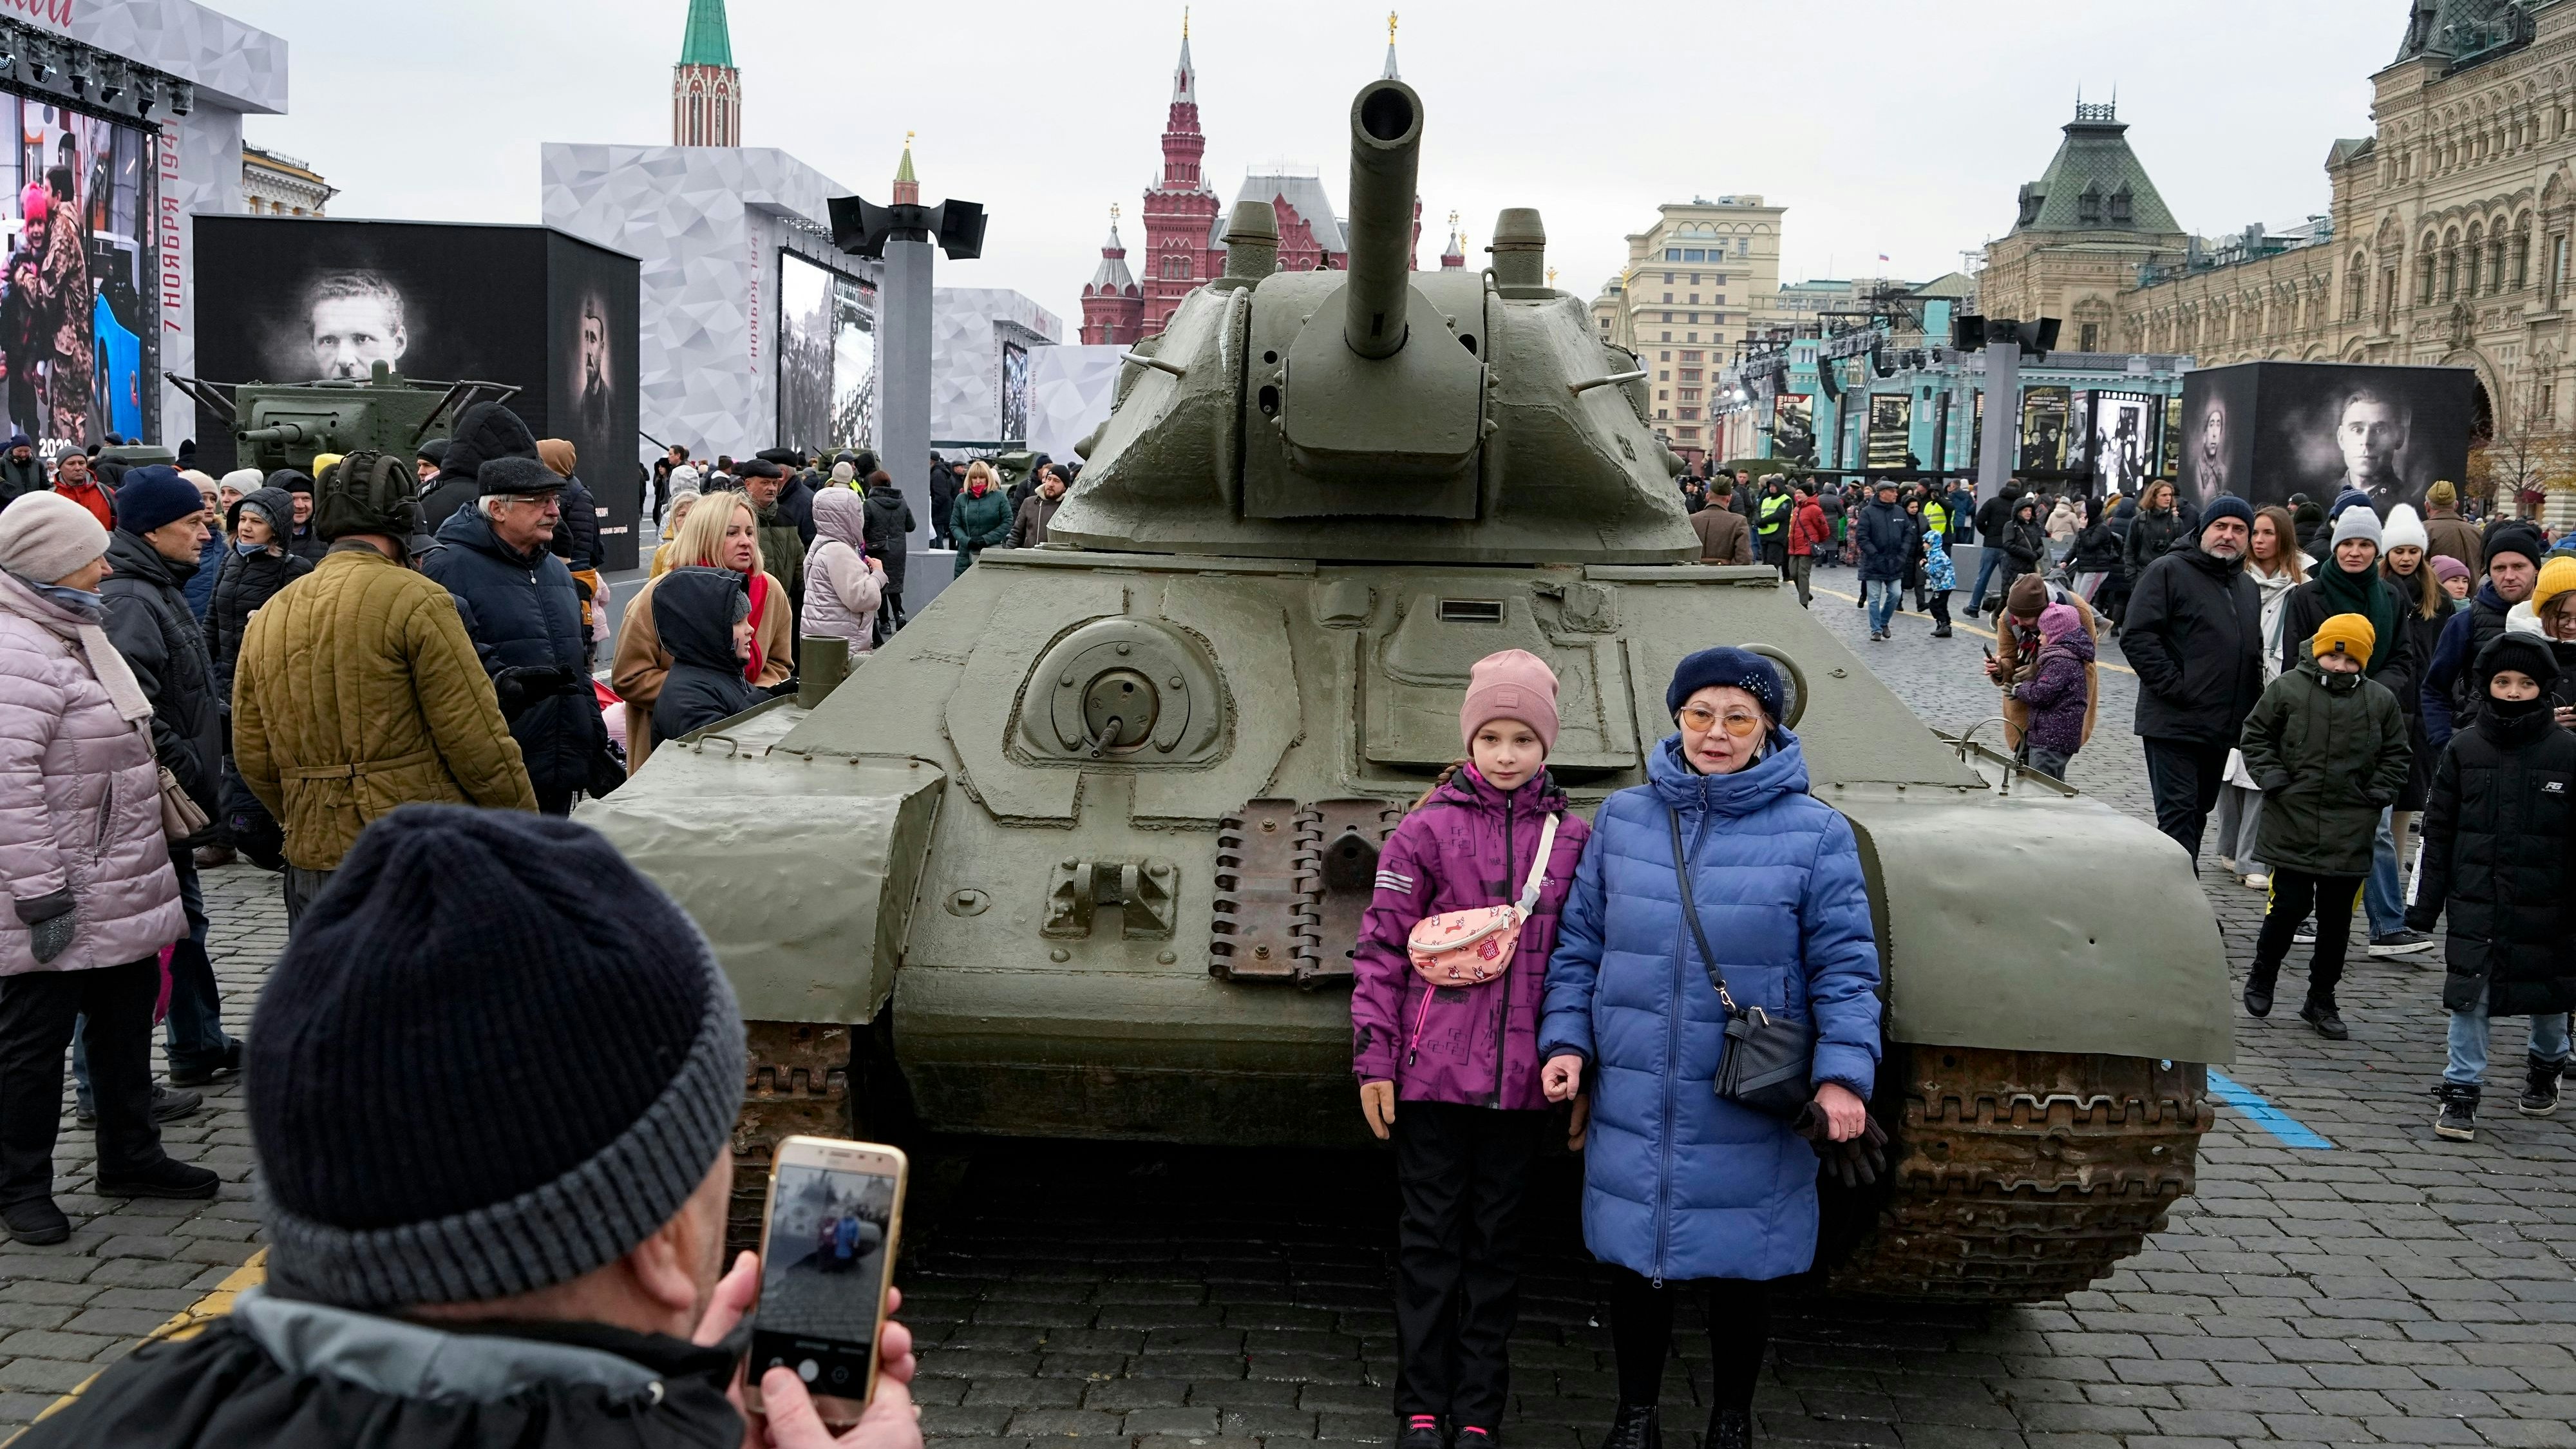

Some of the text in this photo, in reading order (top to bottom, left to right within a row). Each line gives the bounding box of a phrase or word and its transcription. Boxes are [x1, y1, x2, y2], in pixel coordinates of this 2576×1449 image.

[161, 118, 182, 333] 7 НОЯБРЯ 1941
[750, 366, 757, 375] 7
